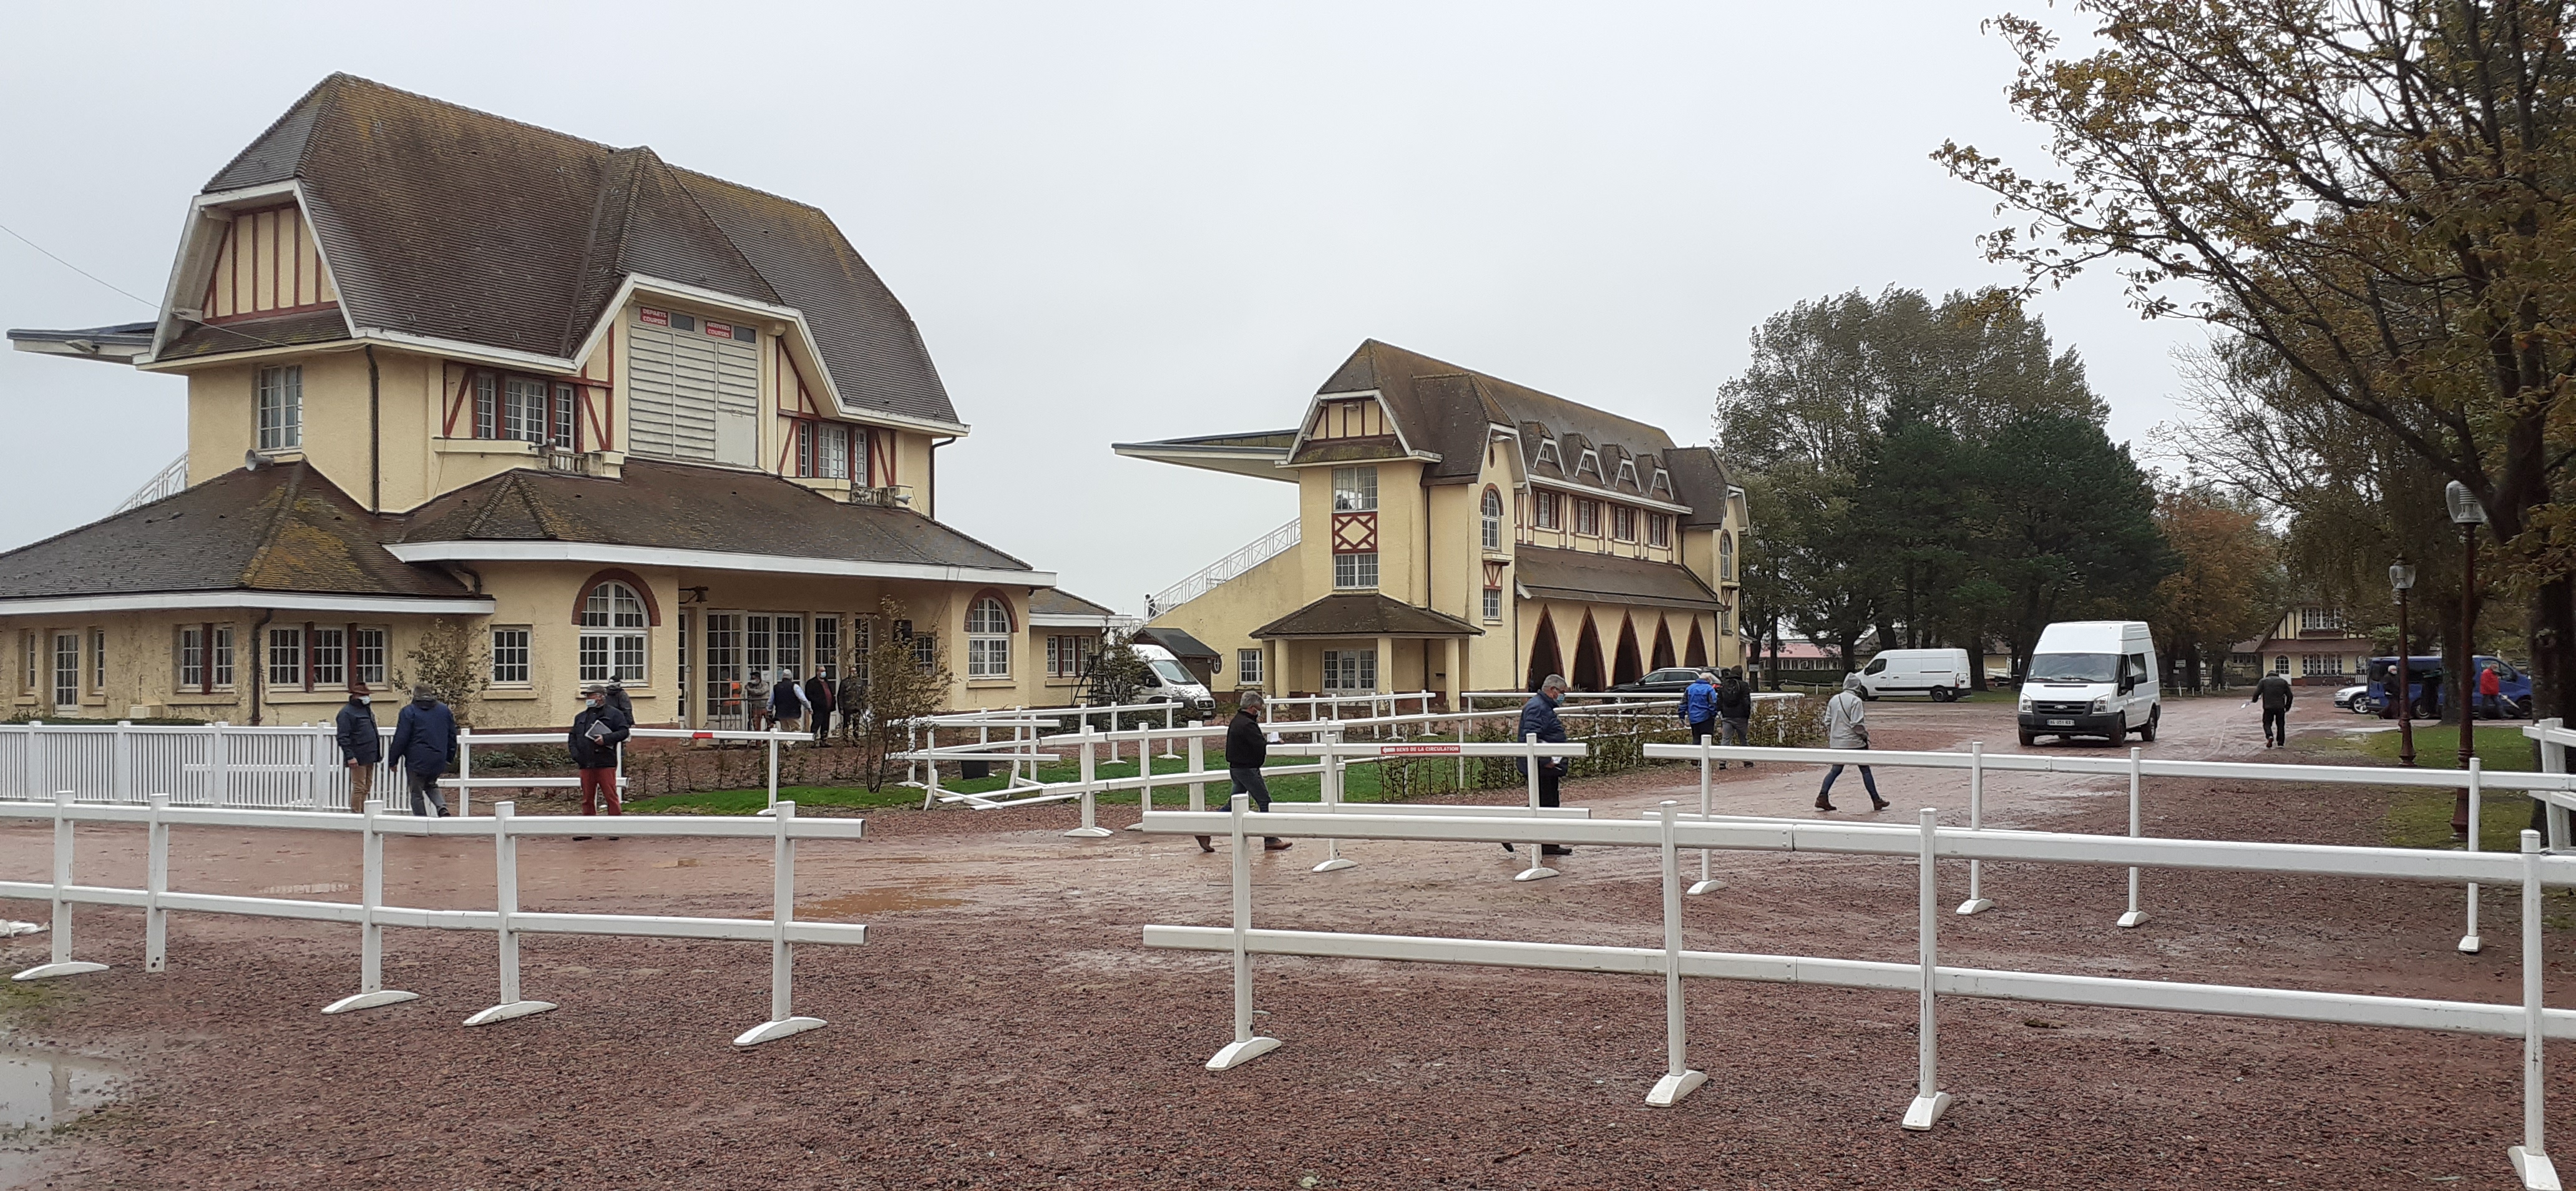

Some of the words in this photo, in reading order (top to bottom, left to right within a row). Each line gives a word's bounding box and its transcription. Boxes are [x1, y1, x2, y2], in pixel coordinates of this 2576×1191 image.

[642, 308, 667, 318] DEPARTS
[643, 315, 666, 325] COURSES
[706, 321, 731, 331] ARRIVEES
[707, 328, 729, 338] COURSES
